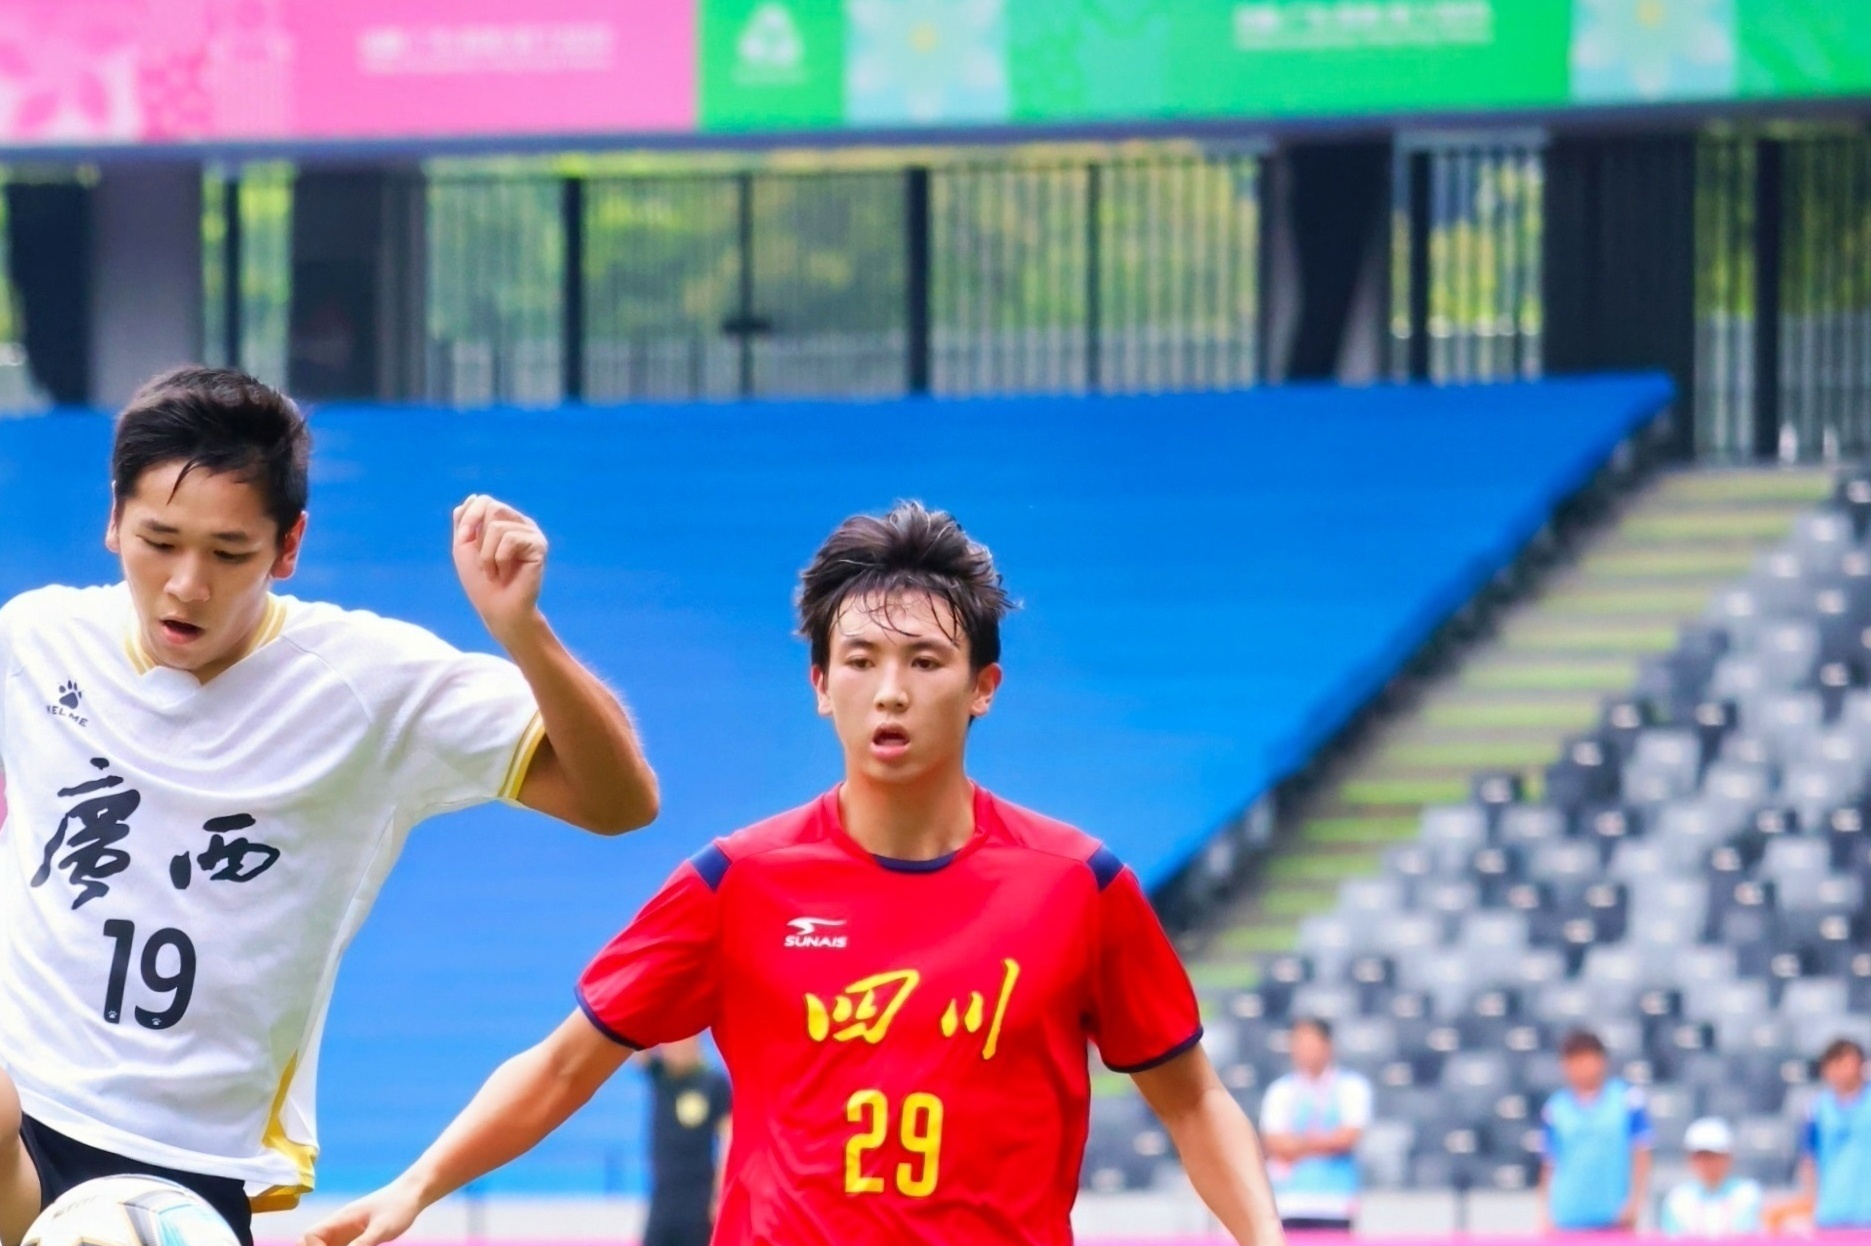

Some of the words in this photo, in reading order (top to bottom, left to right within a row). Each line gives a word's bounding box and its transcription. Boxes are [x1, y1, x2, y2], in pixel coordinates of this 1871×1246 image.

[46, 704, 89, 728] KELME
[103, 918, 197, 1030] 19
[784, 935, 848, 948] SUNAIS
[804, 958, 1020, 1060] 四川
[844, 1088, 944, 1197] 29
